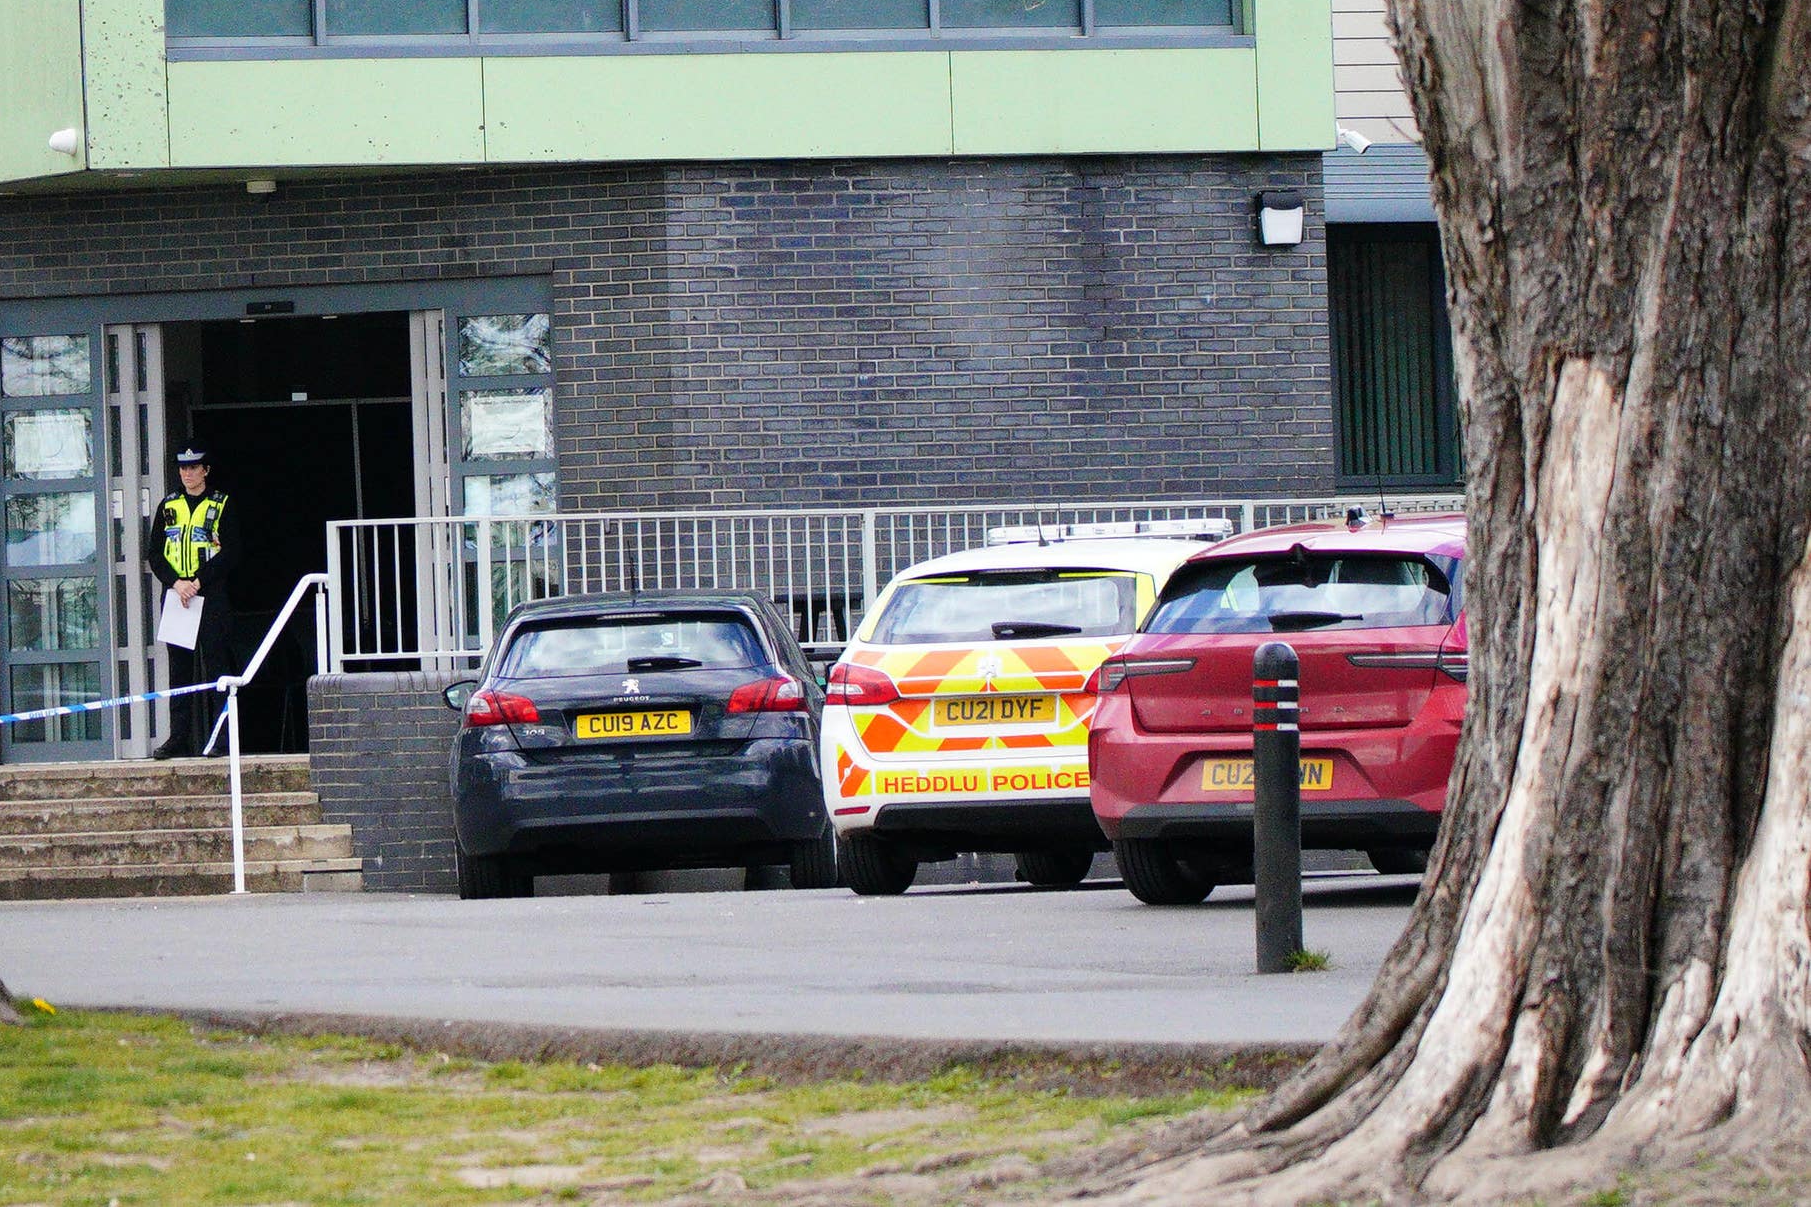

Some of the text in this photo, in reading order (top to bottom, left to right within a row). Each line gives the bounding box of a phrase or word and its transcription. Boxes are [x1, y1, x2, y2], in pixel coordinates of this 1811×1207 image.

[946, 699, 1043, 721] CU21 DYF
[589, 713, 678, 733] CU19 AZC
[884, 772, 1090, 793] HEDDLU POLICE
[1212, 763, 1255, 785] CU2
